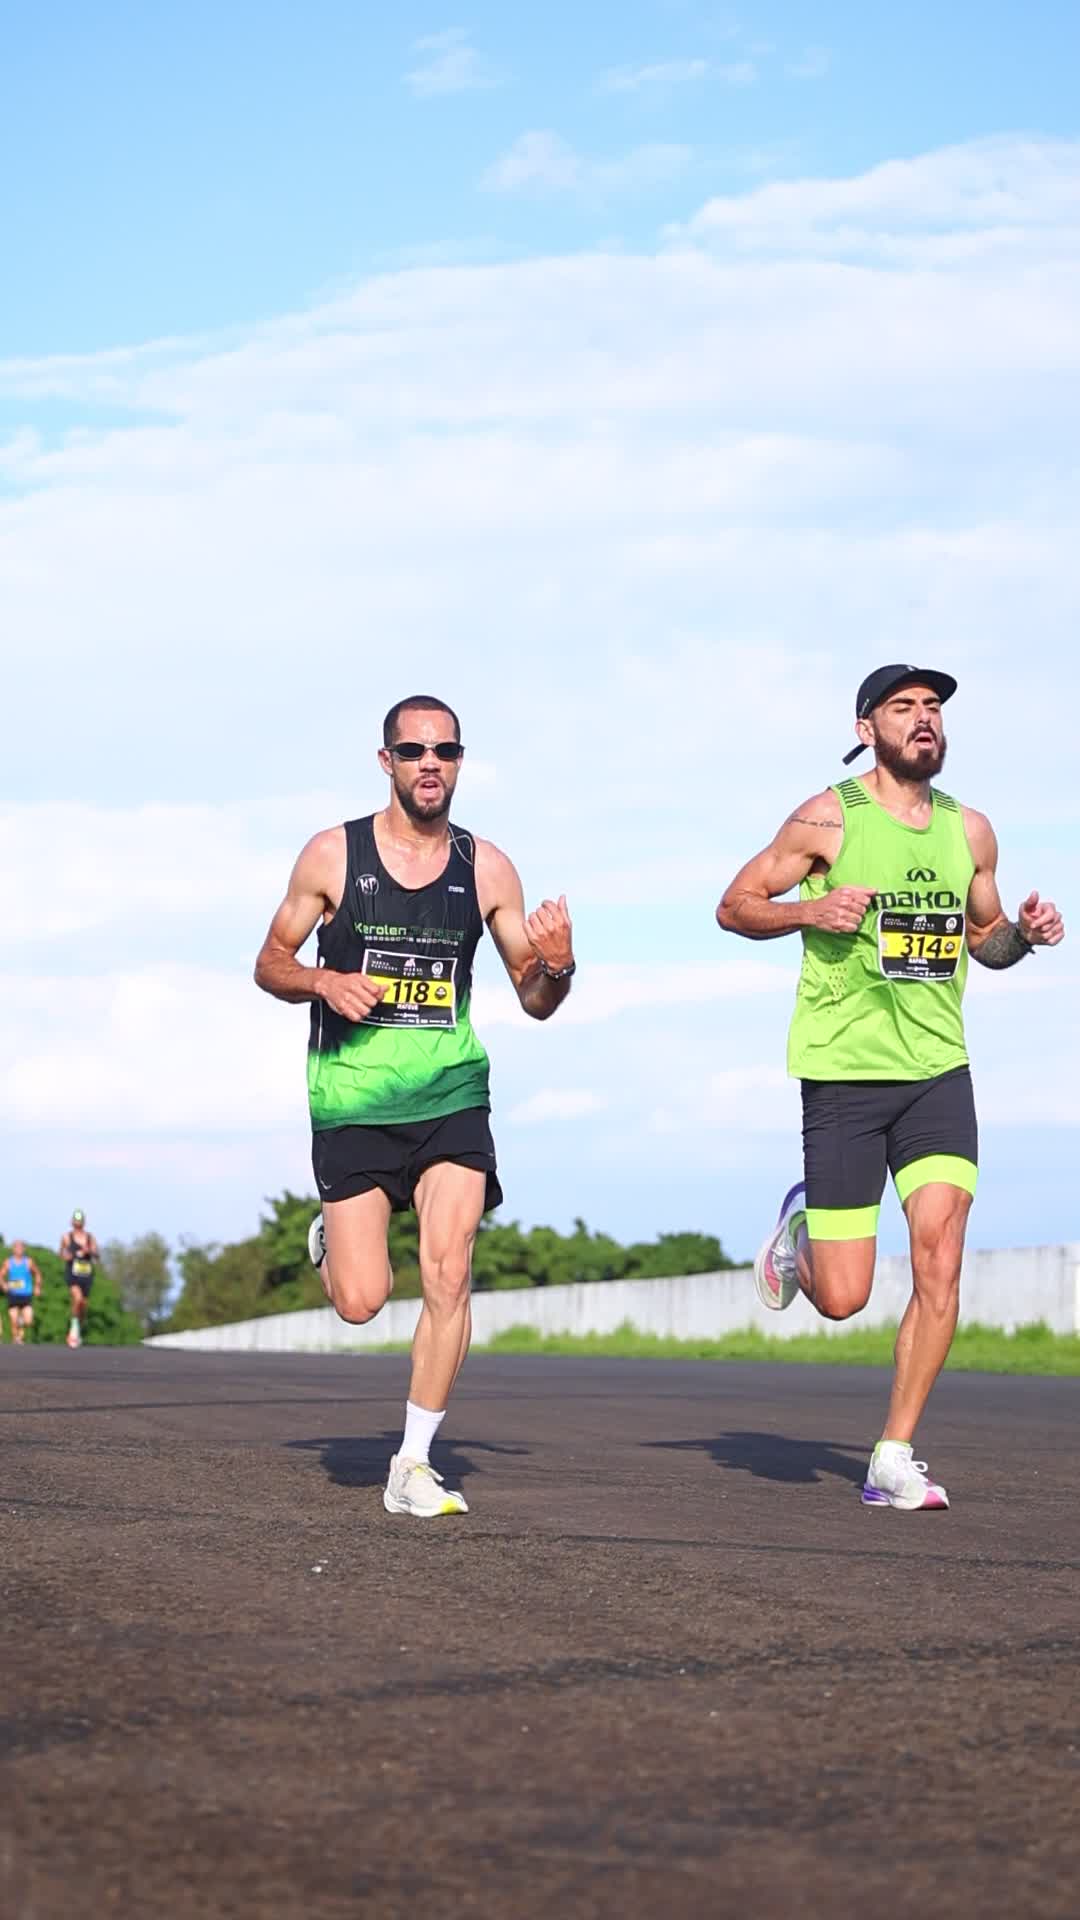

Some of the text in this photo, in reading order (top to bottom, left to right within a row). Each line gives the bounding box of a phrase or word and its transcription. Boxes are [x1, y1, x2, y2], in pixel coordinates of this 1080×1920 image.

[354, 922, 407, 936] Kerolen
[900, 934, 943, 959] 314
[393, 981, 430, 1004] 118
